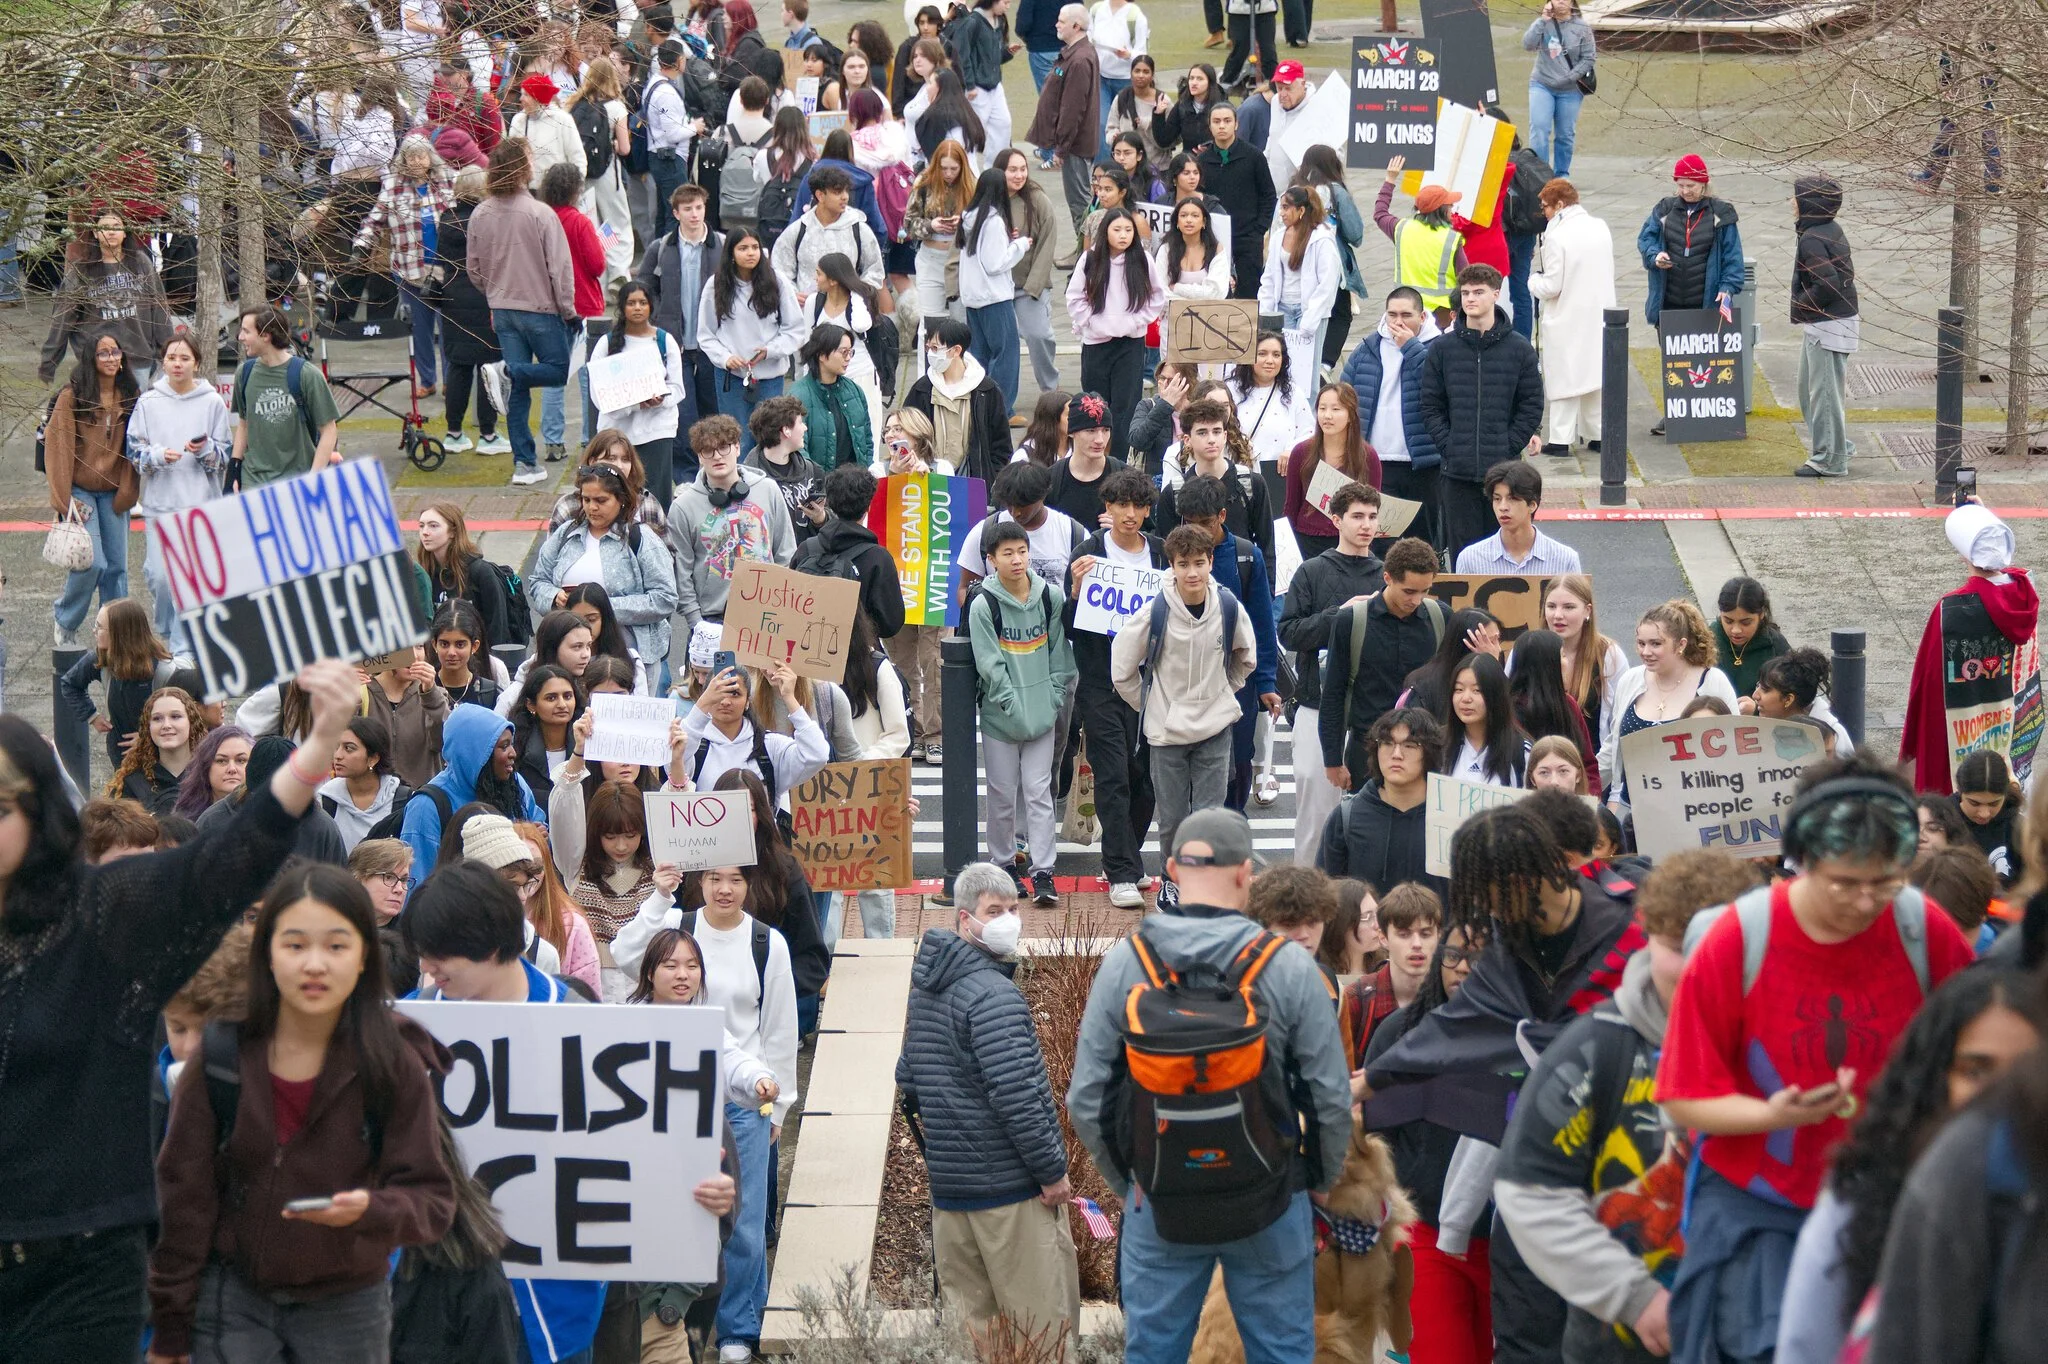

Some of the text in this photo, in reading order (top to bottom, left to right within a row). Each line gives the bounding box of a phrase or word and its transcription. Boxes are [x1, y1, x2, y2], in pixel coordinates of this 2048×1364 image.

[1357, 68, 1439, 91] MARCH 28
[1355, 122, 1433, 144] NO KINGS
[1179, 312, 1246, 352] ICE
[1666, 332, 1742, 355] MARCH 28
[255, 393, 297, 415] ALOHA
[1667, 397, 1736, 418] NO KINGS
[155, 460, 402, 611] NO HUMAN
[901, 483, 922, 564] STAND
[928, 490, 952, 613] WITH YOU
[1089, 561, 1125, 585] ICE
[1087, 583, 1155, 615] COLO
[180, 552, 430, 704] IS ILLEGAL
[1953, 707, 2012, 747] WOMEN'S
[1661, 726, 1762, 761] ICE
[867, 765, 903, 798] IS
[1642, 775, 1662, 789] is
[1681, 771, 1744, 793] killing
[670, 797, 726, 828] NO
[1685, 797, 1753, 821] people
[669, 836, 717, 848] HUMAN
[793, 841, 854, 862] YOU
